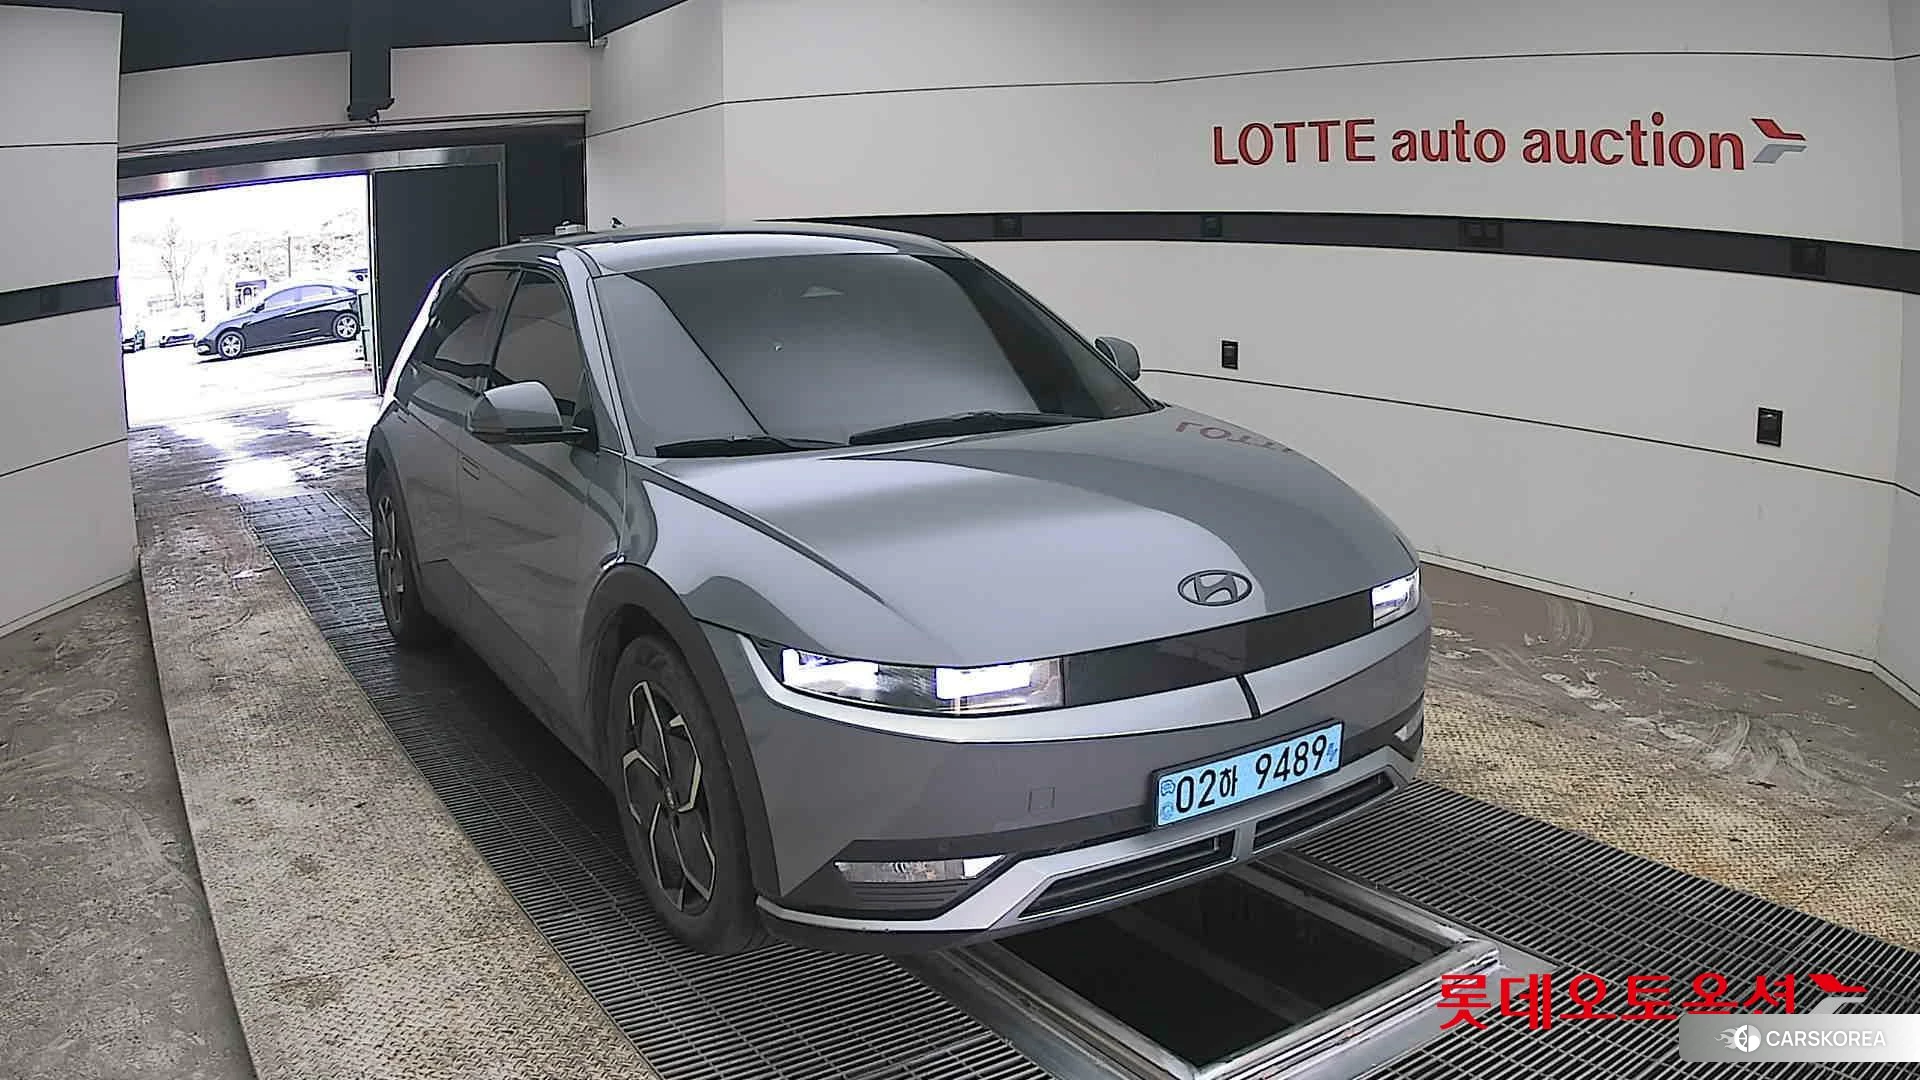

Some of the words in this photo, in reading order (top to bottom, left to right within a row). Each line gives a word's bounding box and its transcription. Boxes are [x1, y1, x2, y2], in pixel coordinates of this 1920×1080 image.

[1213, 118, 1376, 166] LOTTE
[1391, 119, 1506, 163] auto
[1522, 111, 1745, 170] auction
[1175, 765, 1238, 814] 02하
[1255, 734, 1328, 790] 9489
